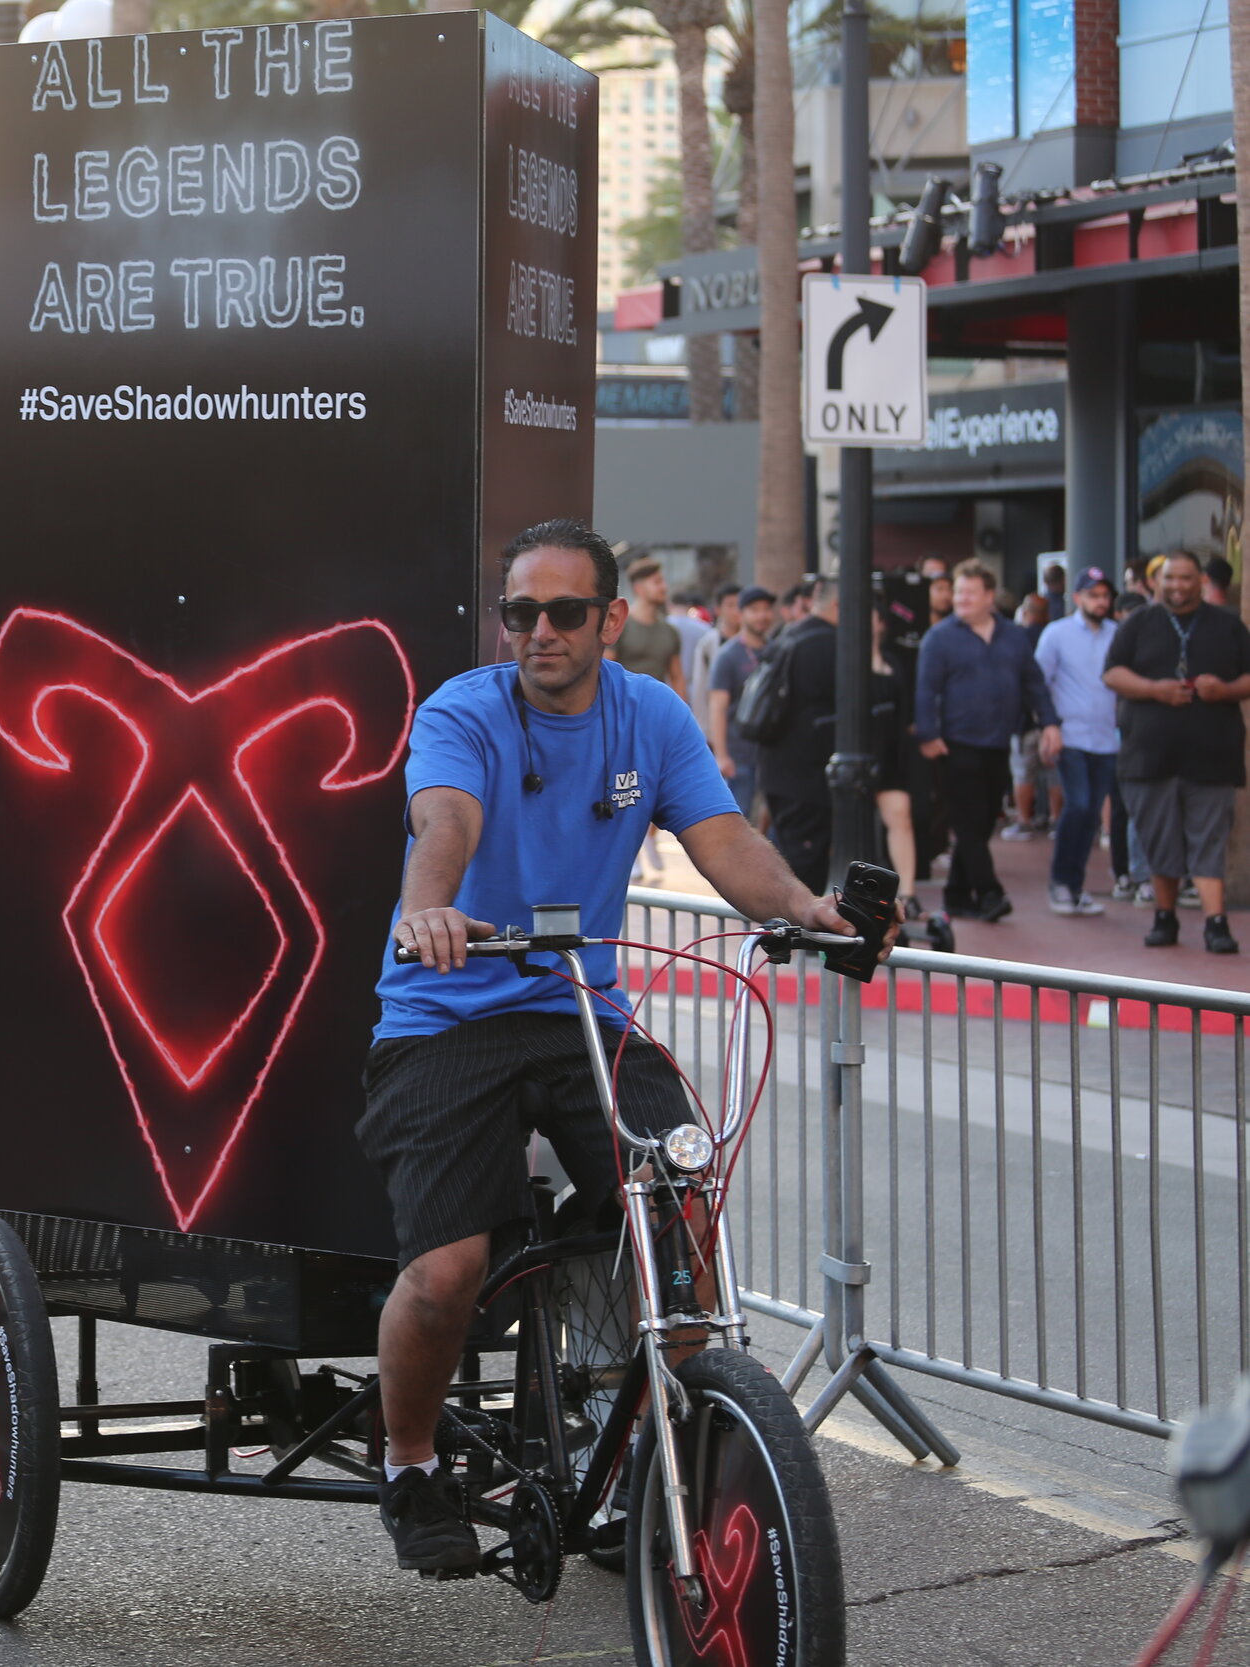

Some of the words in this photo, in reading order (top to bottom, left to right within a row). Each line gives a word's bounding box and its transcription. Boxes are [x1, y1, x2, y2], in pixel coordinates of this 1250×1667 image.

[32, 34, 169, 111] ALL
[202, 22, 353, 99] THE
[547, 60, 577, 129] THE
[32, 136, 362, 222] LEGENDS
[508, 143, 578, 238] LEGENDS
[29, 259, 155, 333] ARE
[170, 254, 365, 328] TRUE.
[507, 260, 537, 337] ARE
[538, 269, 578, 346] TRUE.
[19, 384, 367, 422] #SaveShadowhunters
[504, 388, 577, 431] #SaveShadowhunters
[822, 403, 907, 433] ONLY
[896, 403, 1059, 457] ellExperience
[672, 1270, 692, 1285] 25
